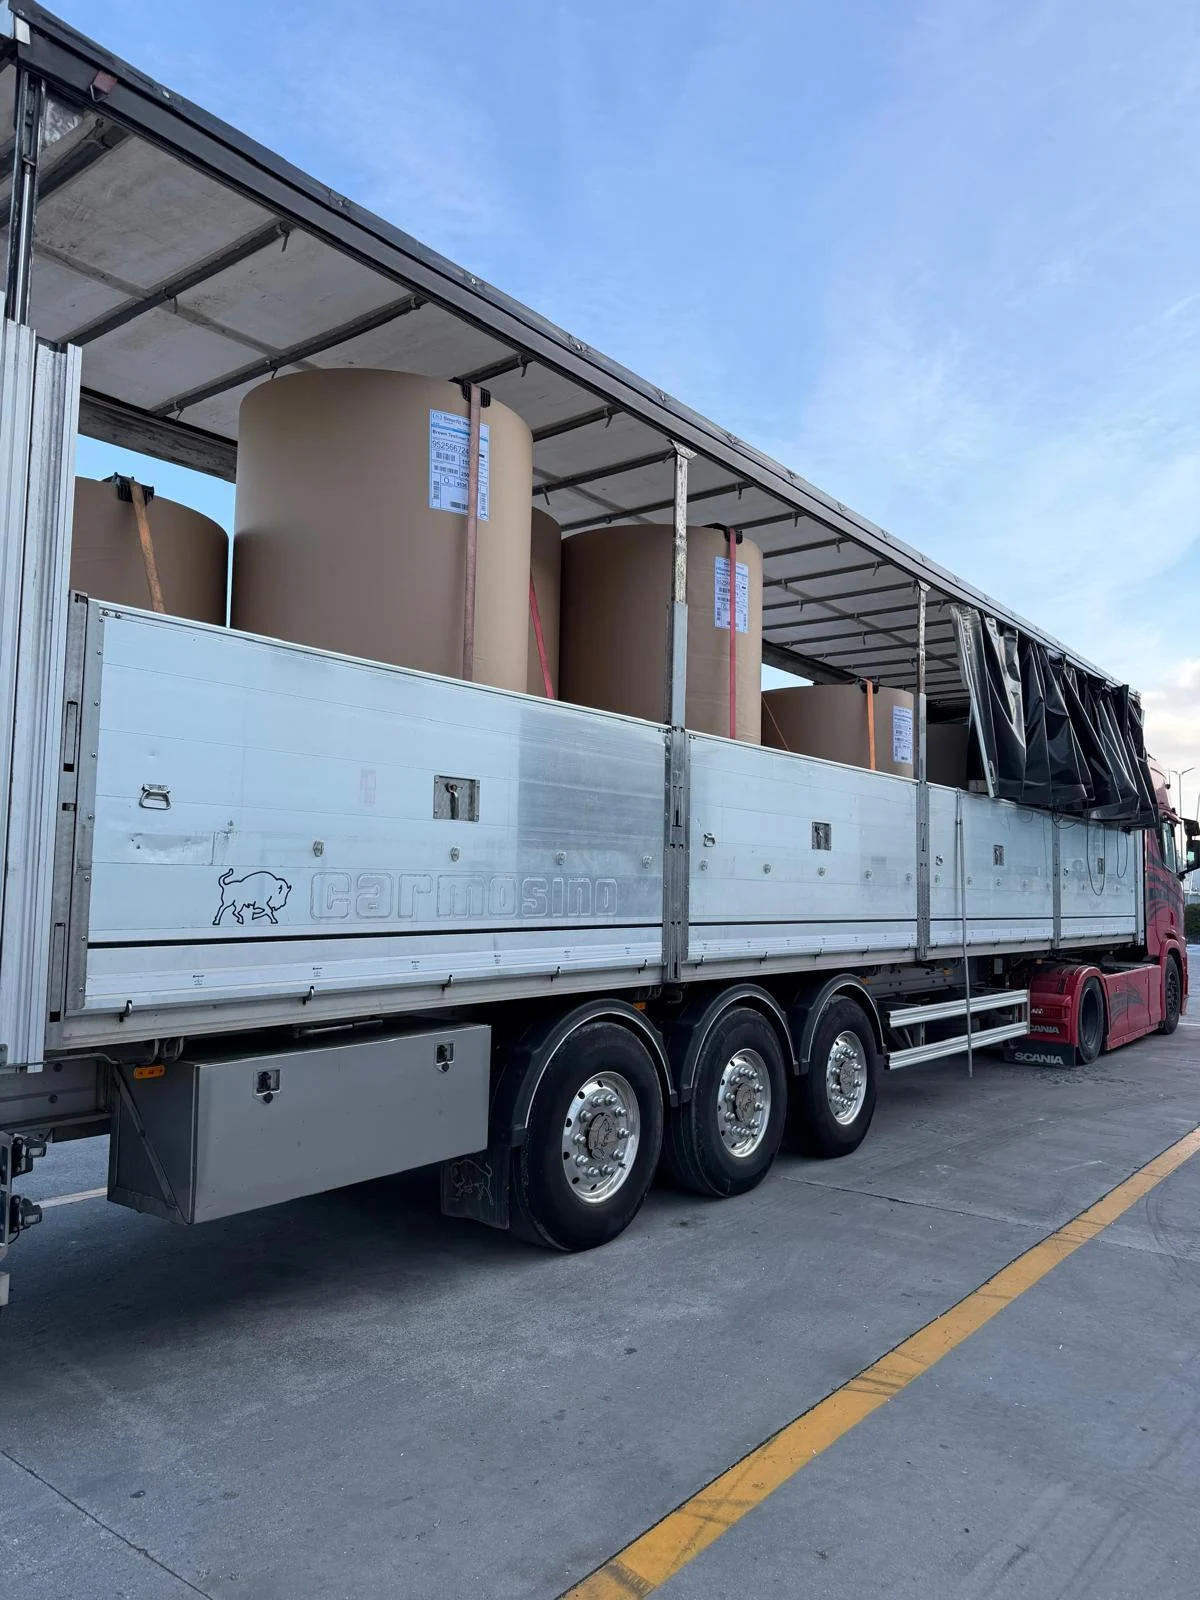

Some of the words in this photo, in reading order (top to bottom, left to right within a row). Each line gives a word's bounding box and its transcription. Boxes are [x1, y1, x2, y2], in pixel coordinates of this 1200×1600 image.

[310, 872, 618, 920] carmosino
[1030, 1024, 1060, 1034] CANIA
[1014, 1052, 1064, 1065] SCANIA
